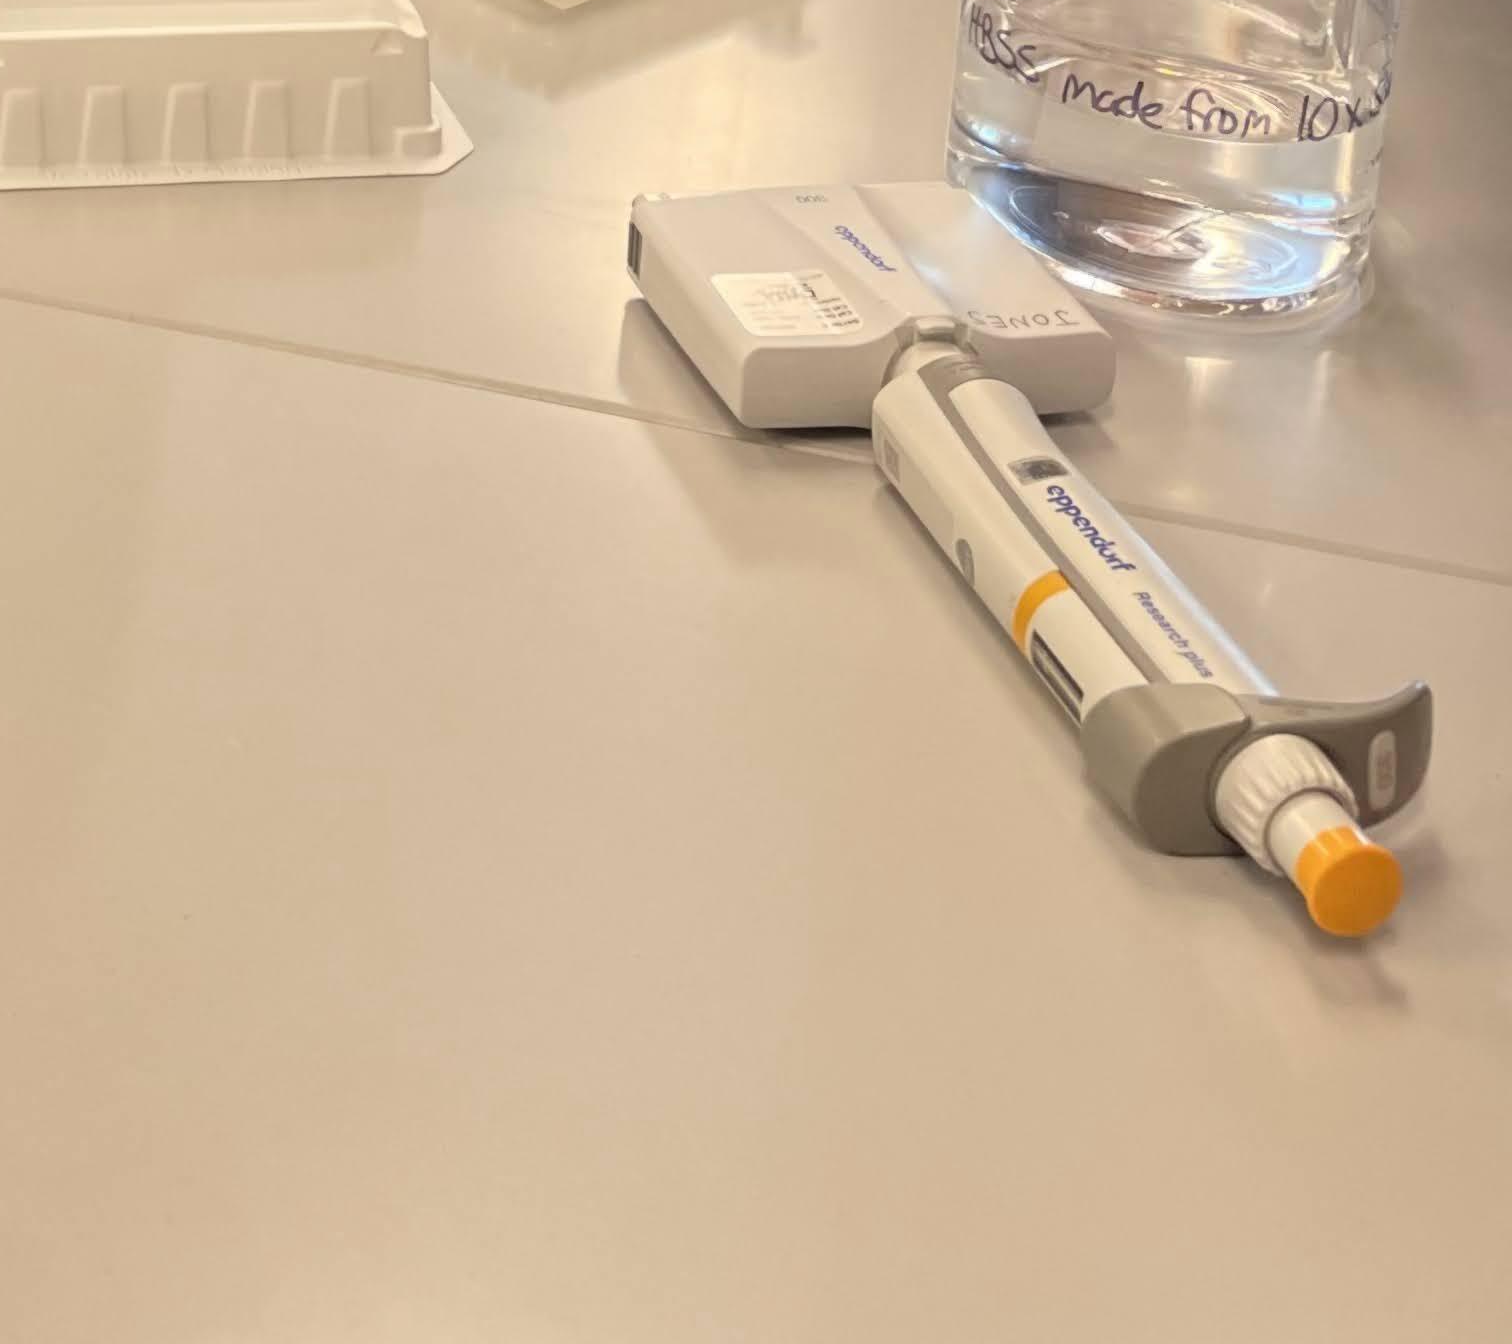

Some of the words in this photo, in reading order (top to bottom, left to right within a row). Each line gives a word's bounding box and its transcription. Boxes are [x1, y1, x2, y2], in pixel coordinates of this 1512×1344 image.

[1180, 87, 1271, 140] from
[1046, 484, 1137, 572] eppendorf
[1132, 591, 1190, 649] Research
[1175, 651, 1214, 679] plus
